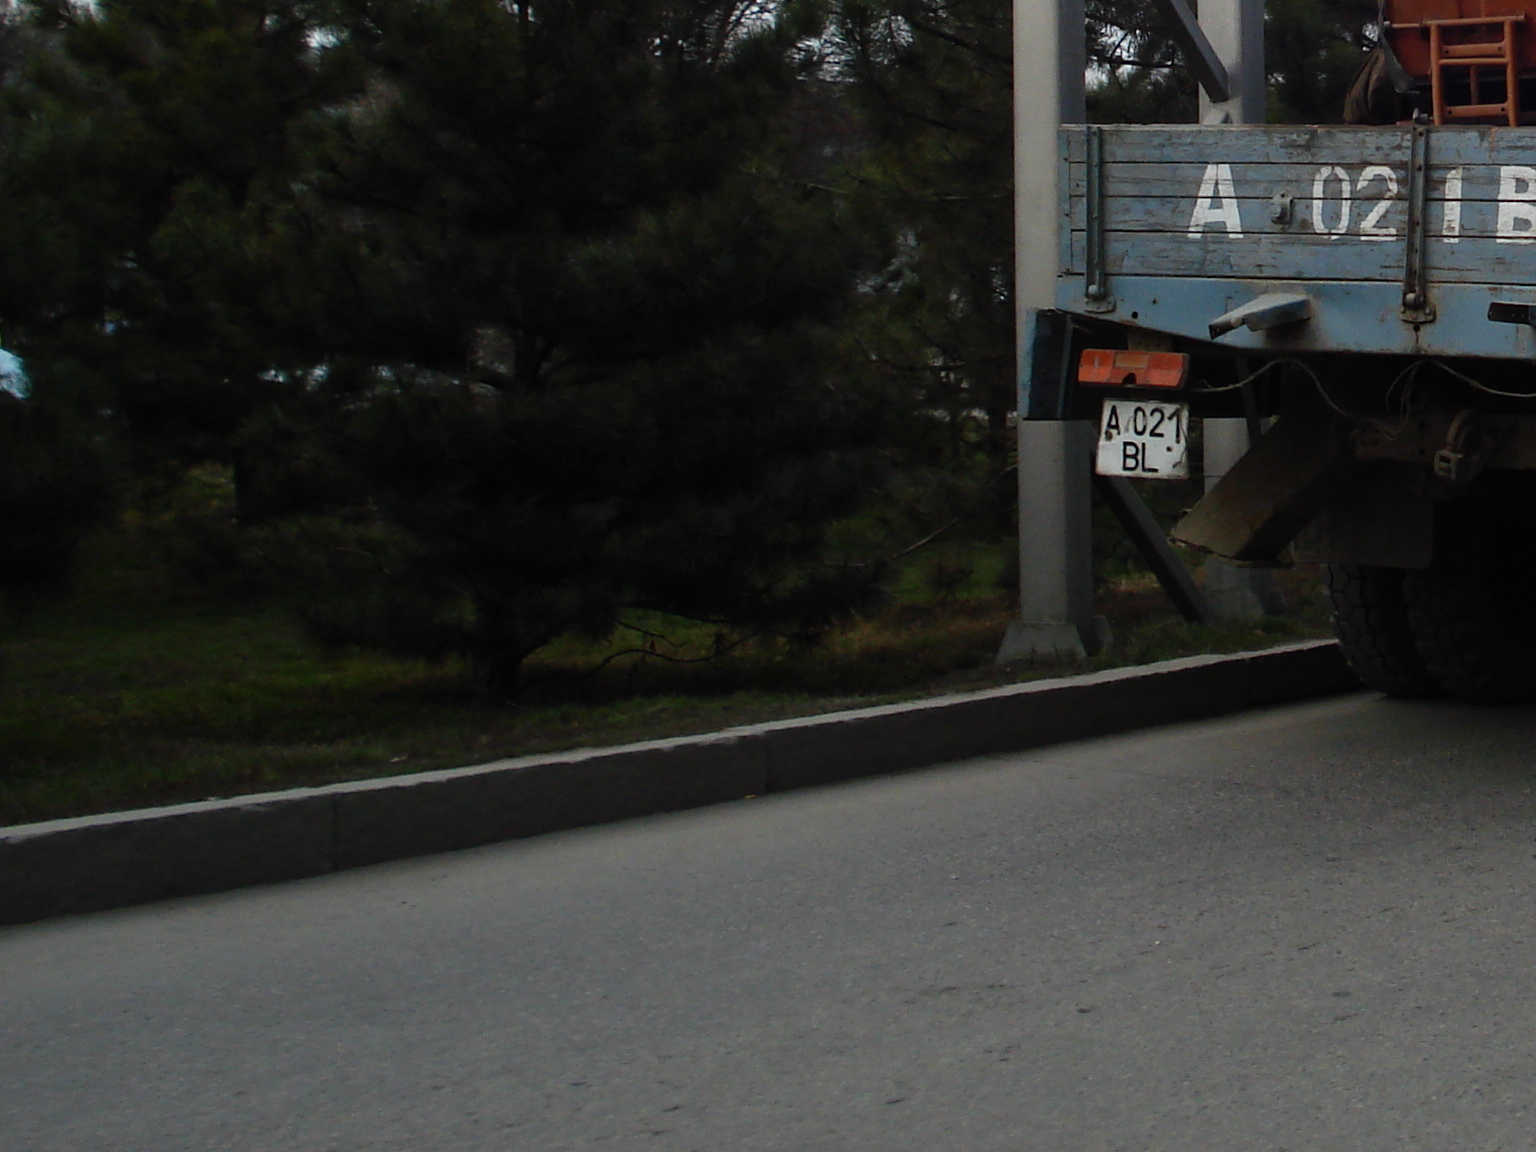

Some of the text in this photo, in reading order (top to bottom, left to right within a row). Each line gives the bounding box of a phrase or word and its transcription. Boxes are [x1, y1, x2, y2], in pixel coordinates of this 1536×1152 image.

[1188, 164, 1243, 239] A
[1105, 405, 1182, 444] A 021
[1123, 441, 1159, 473] BL
